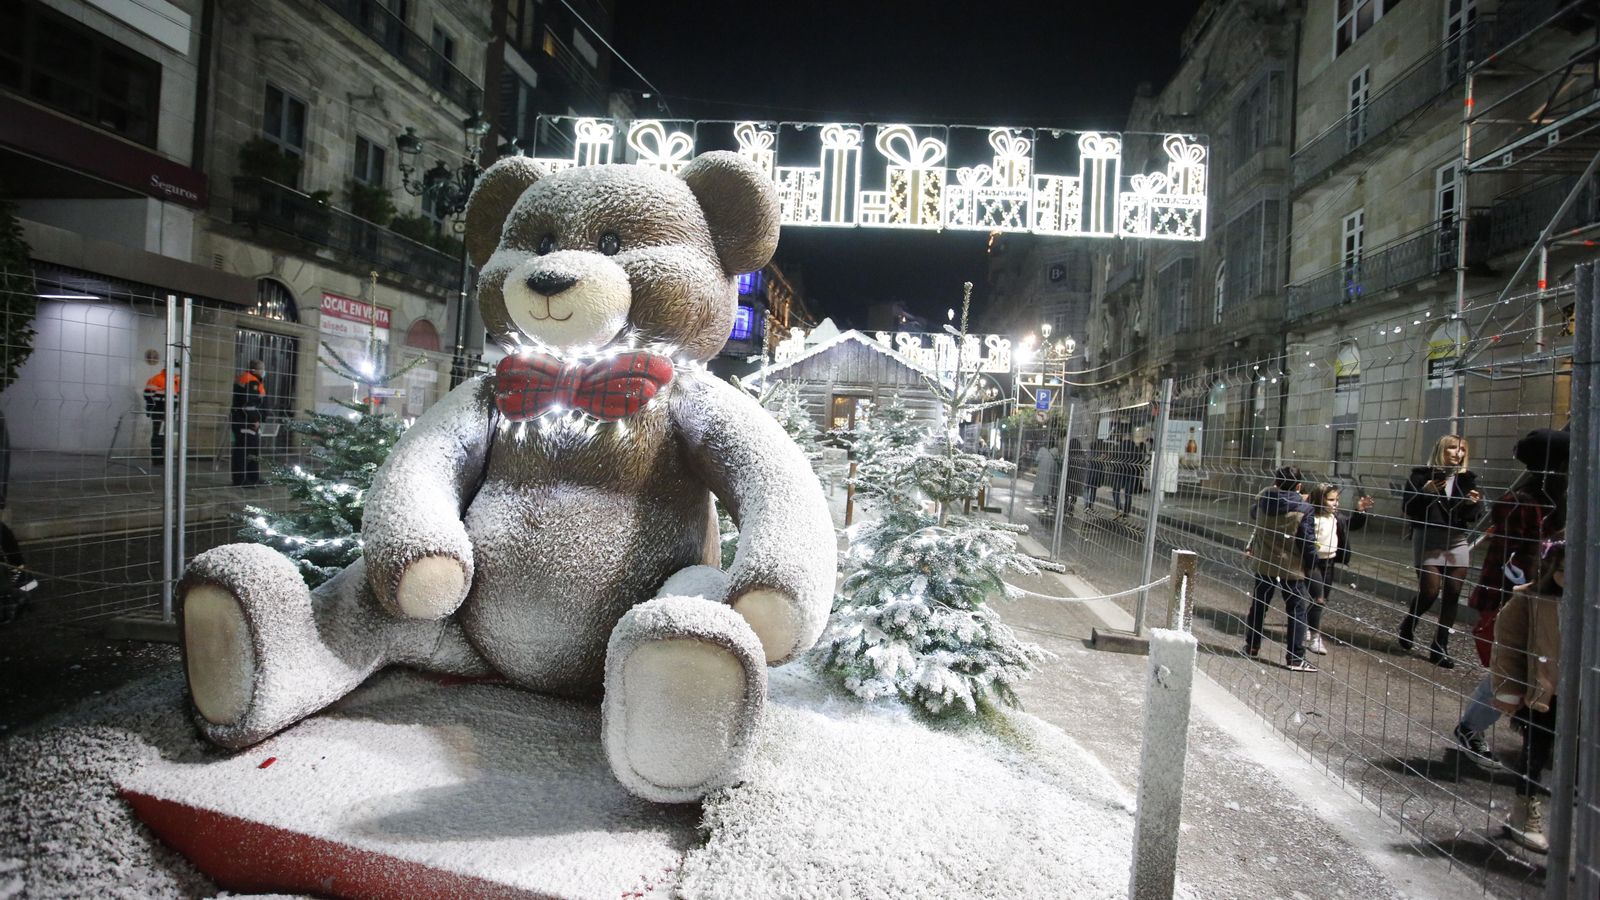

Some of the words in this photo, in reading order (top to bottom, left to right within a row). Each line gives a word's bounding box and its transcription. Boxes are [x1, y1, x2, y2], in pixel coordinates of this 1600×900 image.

[150, 174, 198, 201] Seguros
[350, 303, 362, 317] EN
[363, 305, 389, 323] VENTA
[1040, 392, 1047, 401] P
